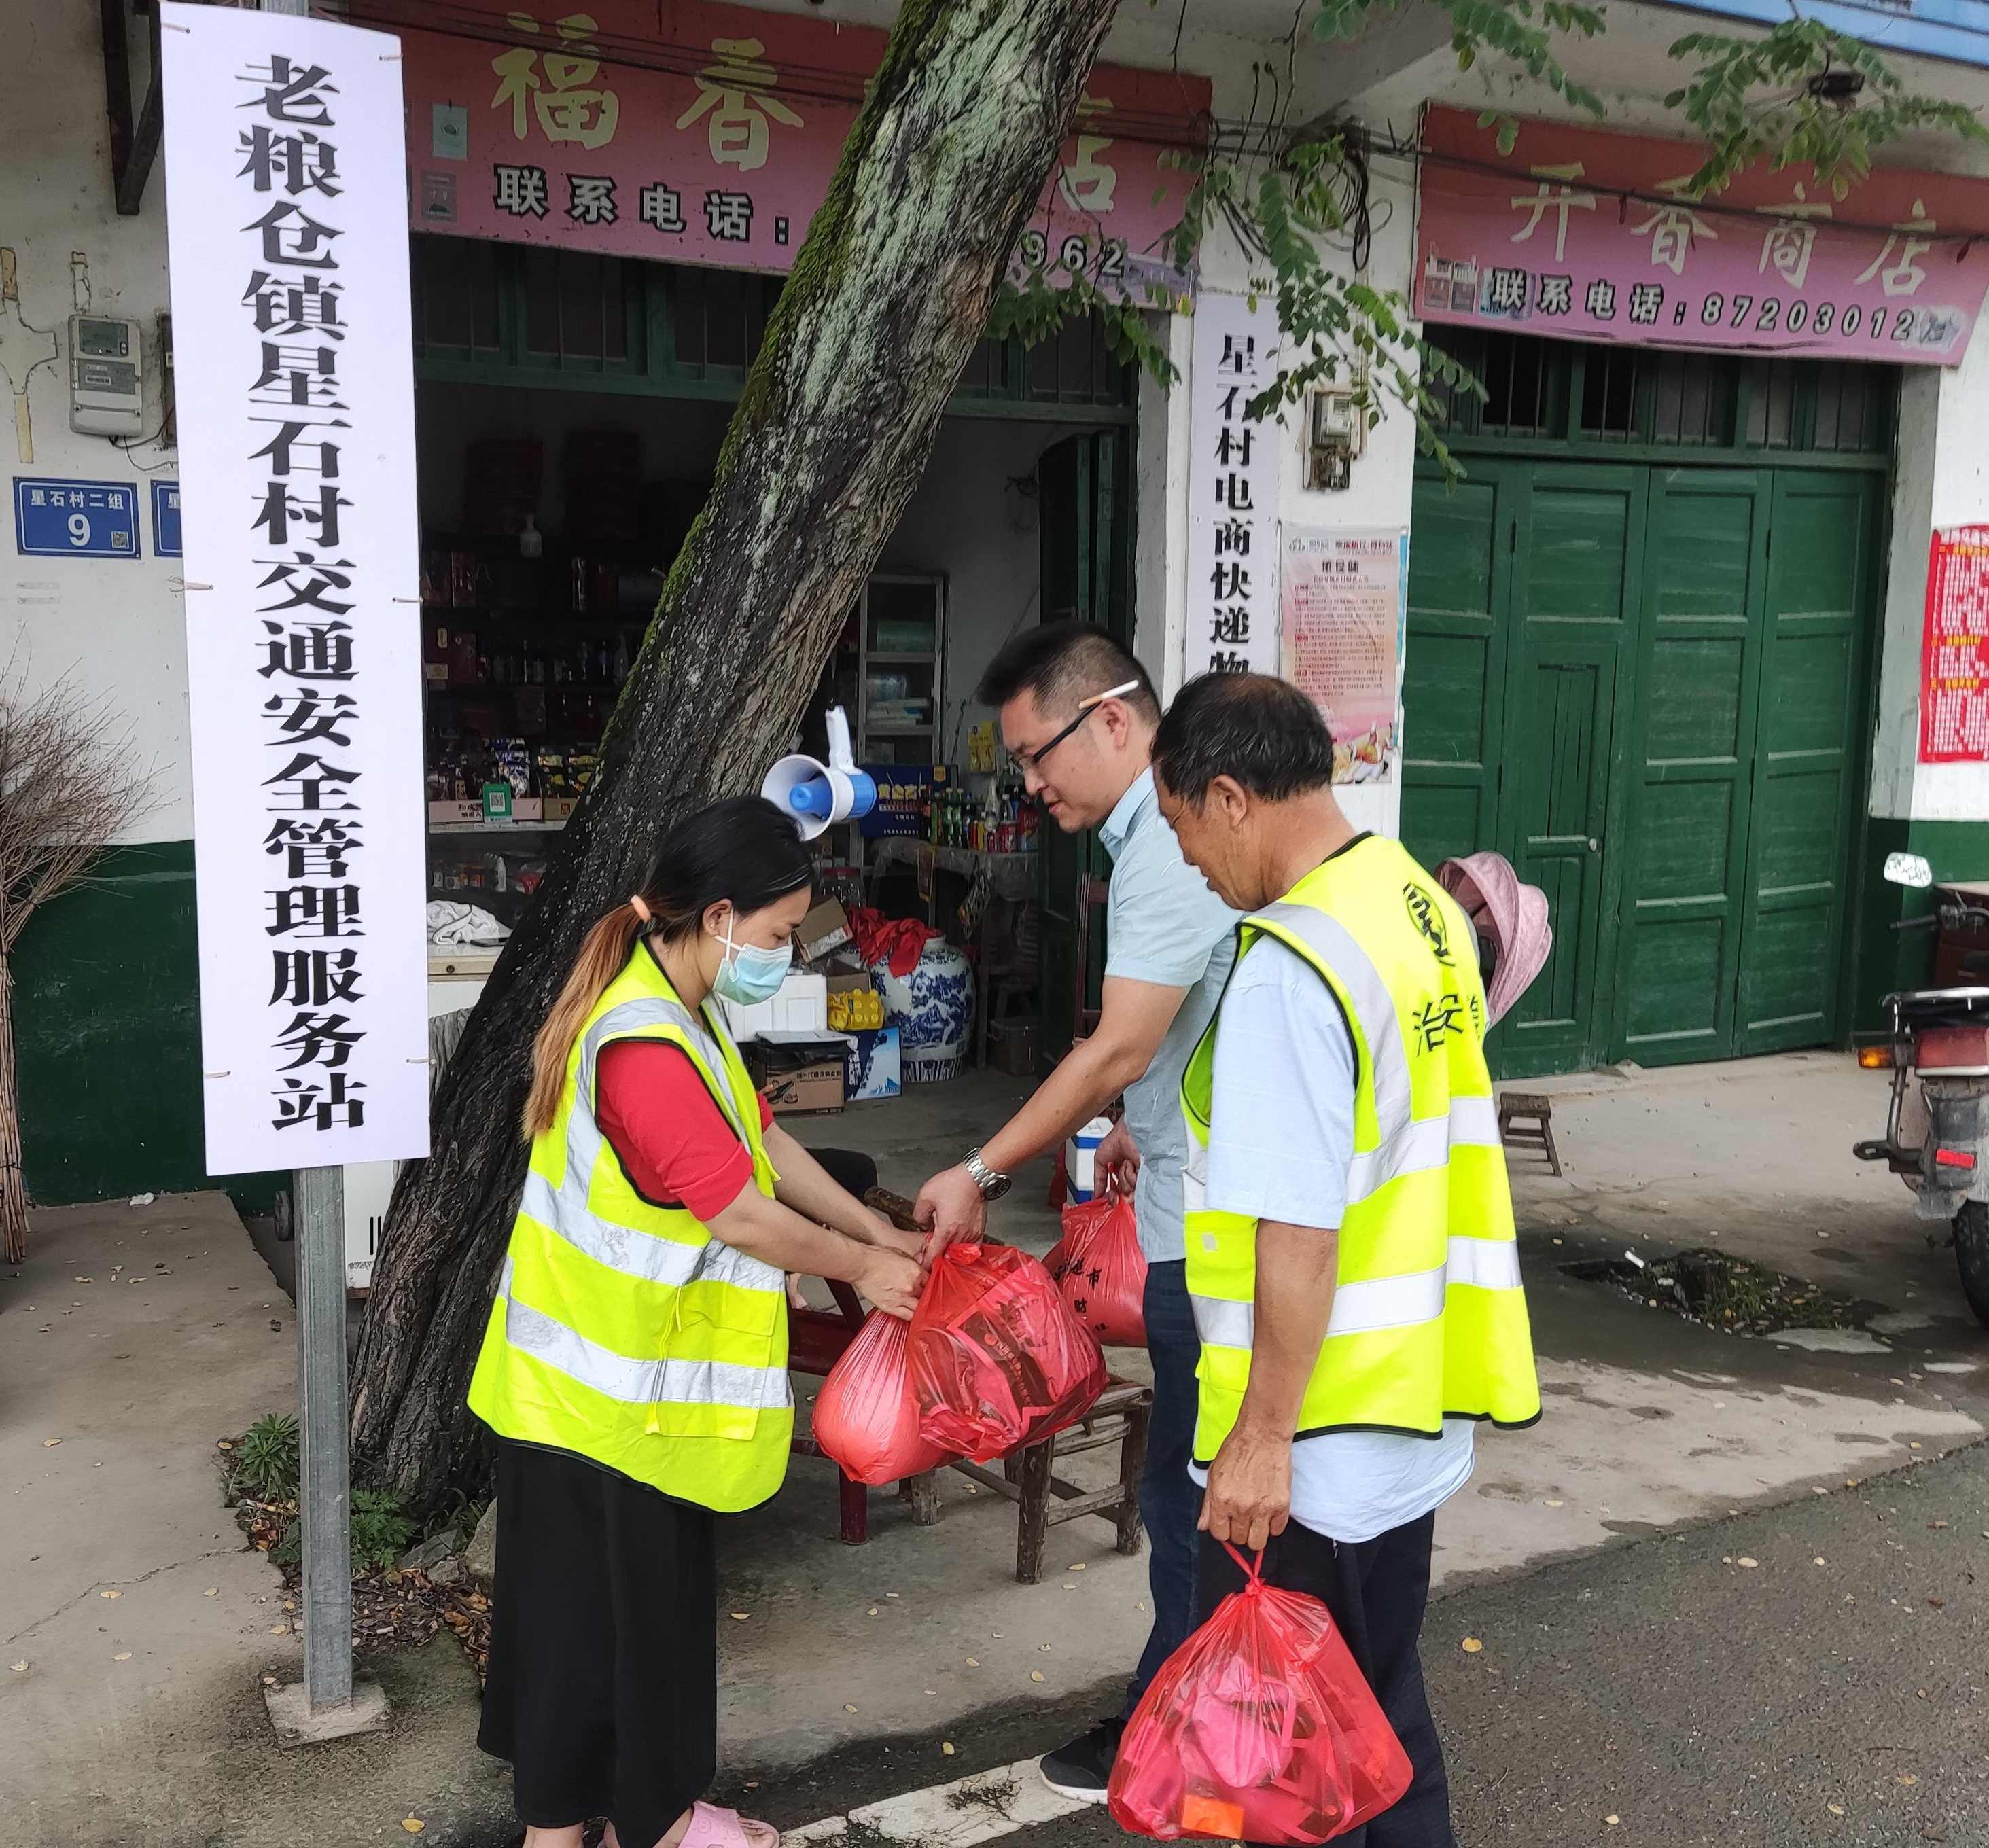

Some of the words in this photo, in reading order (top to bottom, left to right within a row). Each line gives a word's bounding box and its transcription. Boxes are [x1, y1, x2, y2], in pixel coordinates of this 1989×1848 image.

[1509, 161, 1937, 298] 开香商店
[30, 488, 124, 511] 星石村二组
[67, 512, 91, 548] 9
[234, 53, 368, 1131] 老粮仓镇星石村交通安全管理服务站
